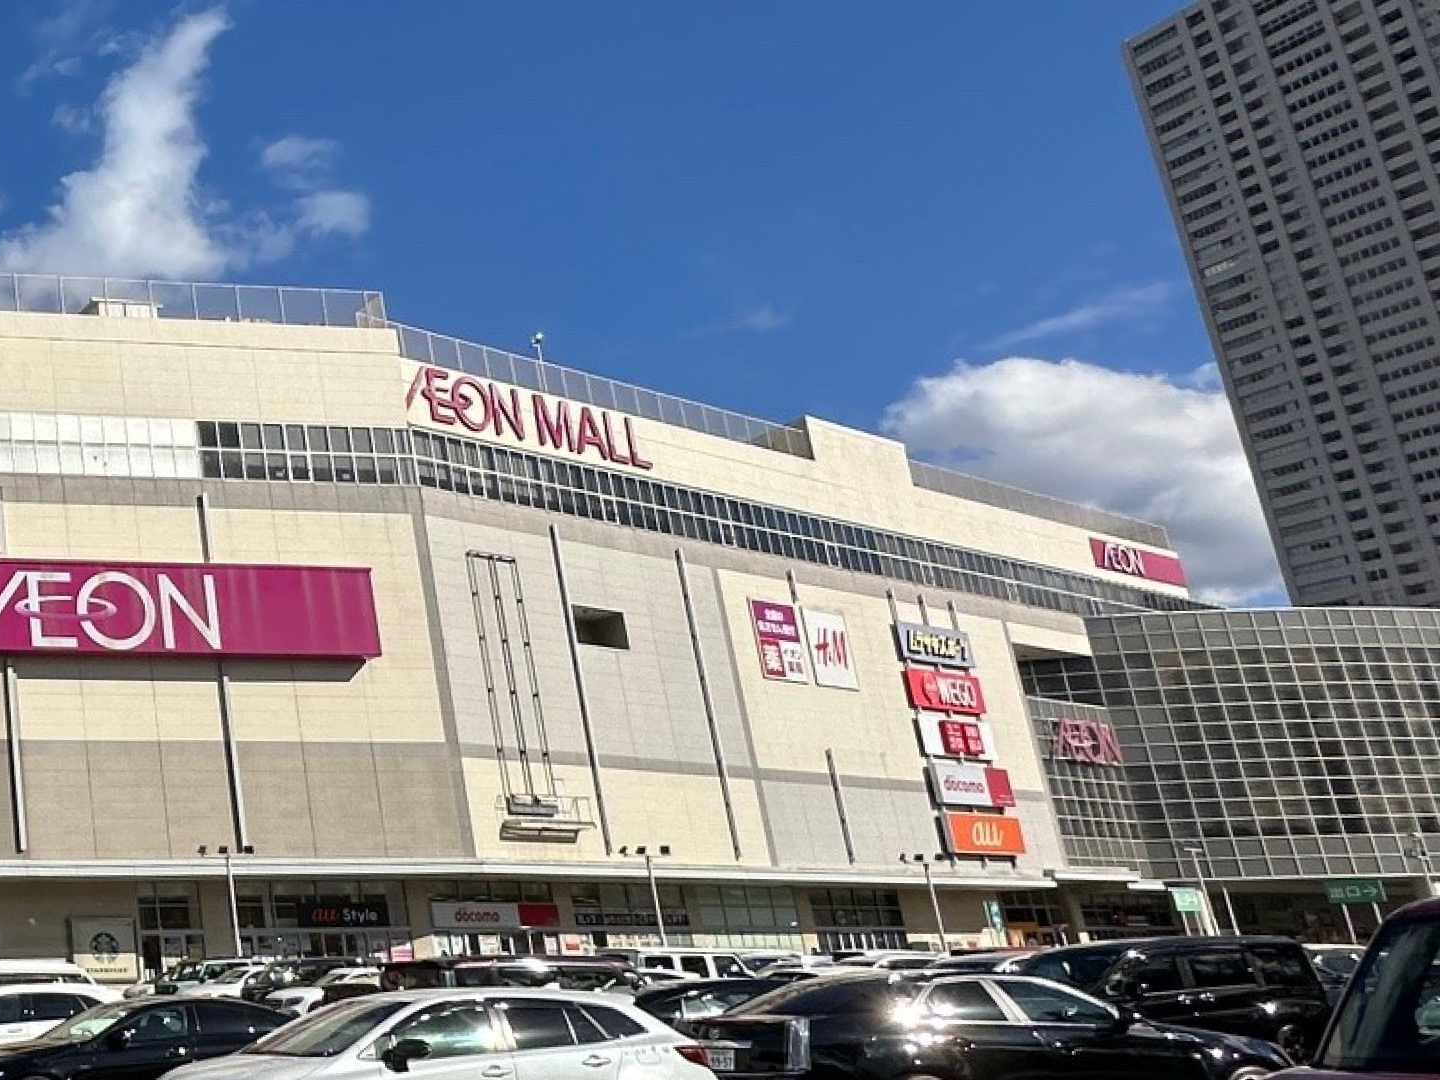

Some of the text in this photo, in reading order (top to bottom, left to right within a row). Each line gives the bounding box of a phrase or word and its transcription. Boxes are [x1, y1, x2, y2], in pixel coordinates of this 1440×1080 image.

[531, 393, 653, 470] MALL
[815, 627, 849, 670] H&M
[936, 678, 976, 706] WEGO
[972, 821, 1004, 846] au
[311, 906, 379, 924] au Style
[454, 907, 501, 922] docomo
